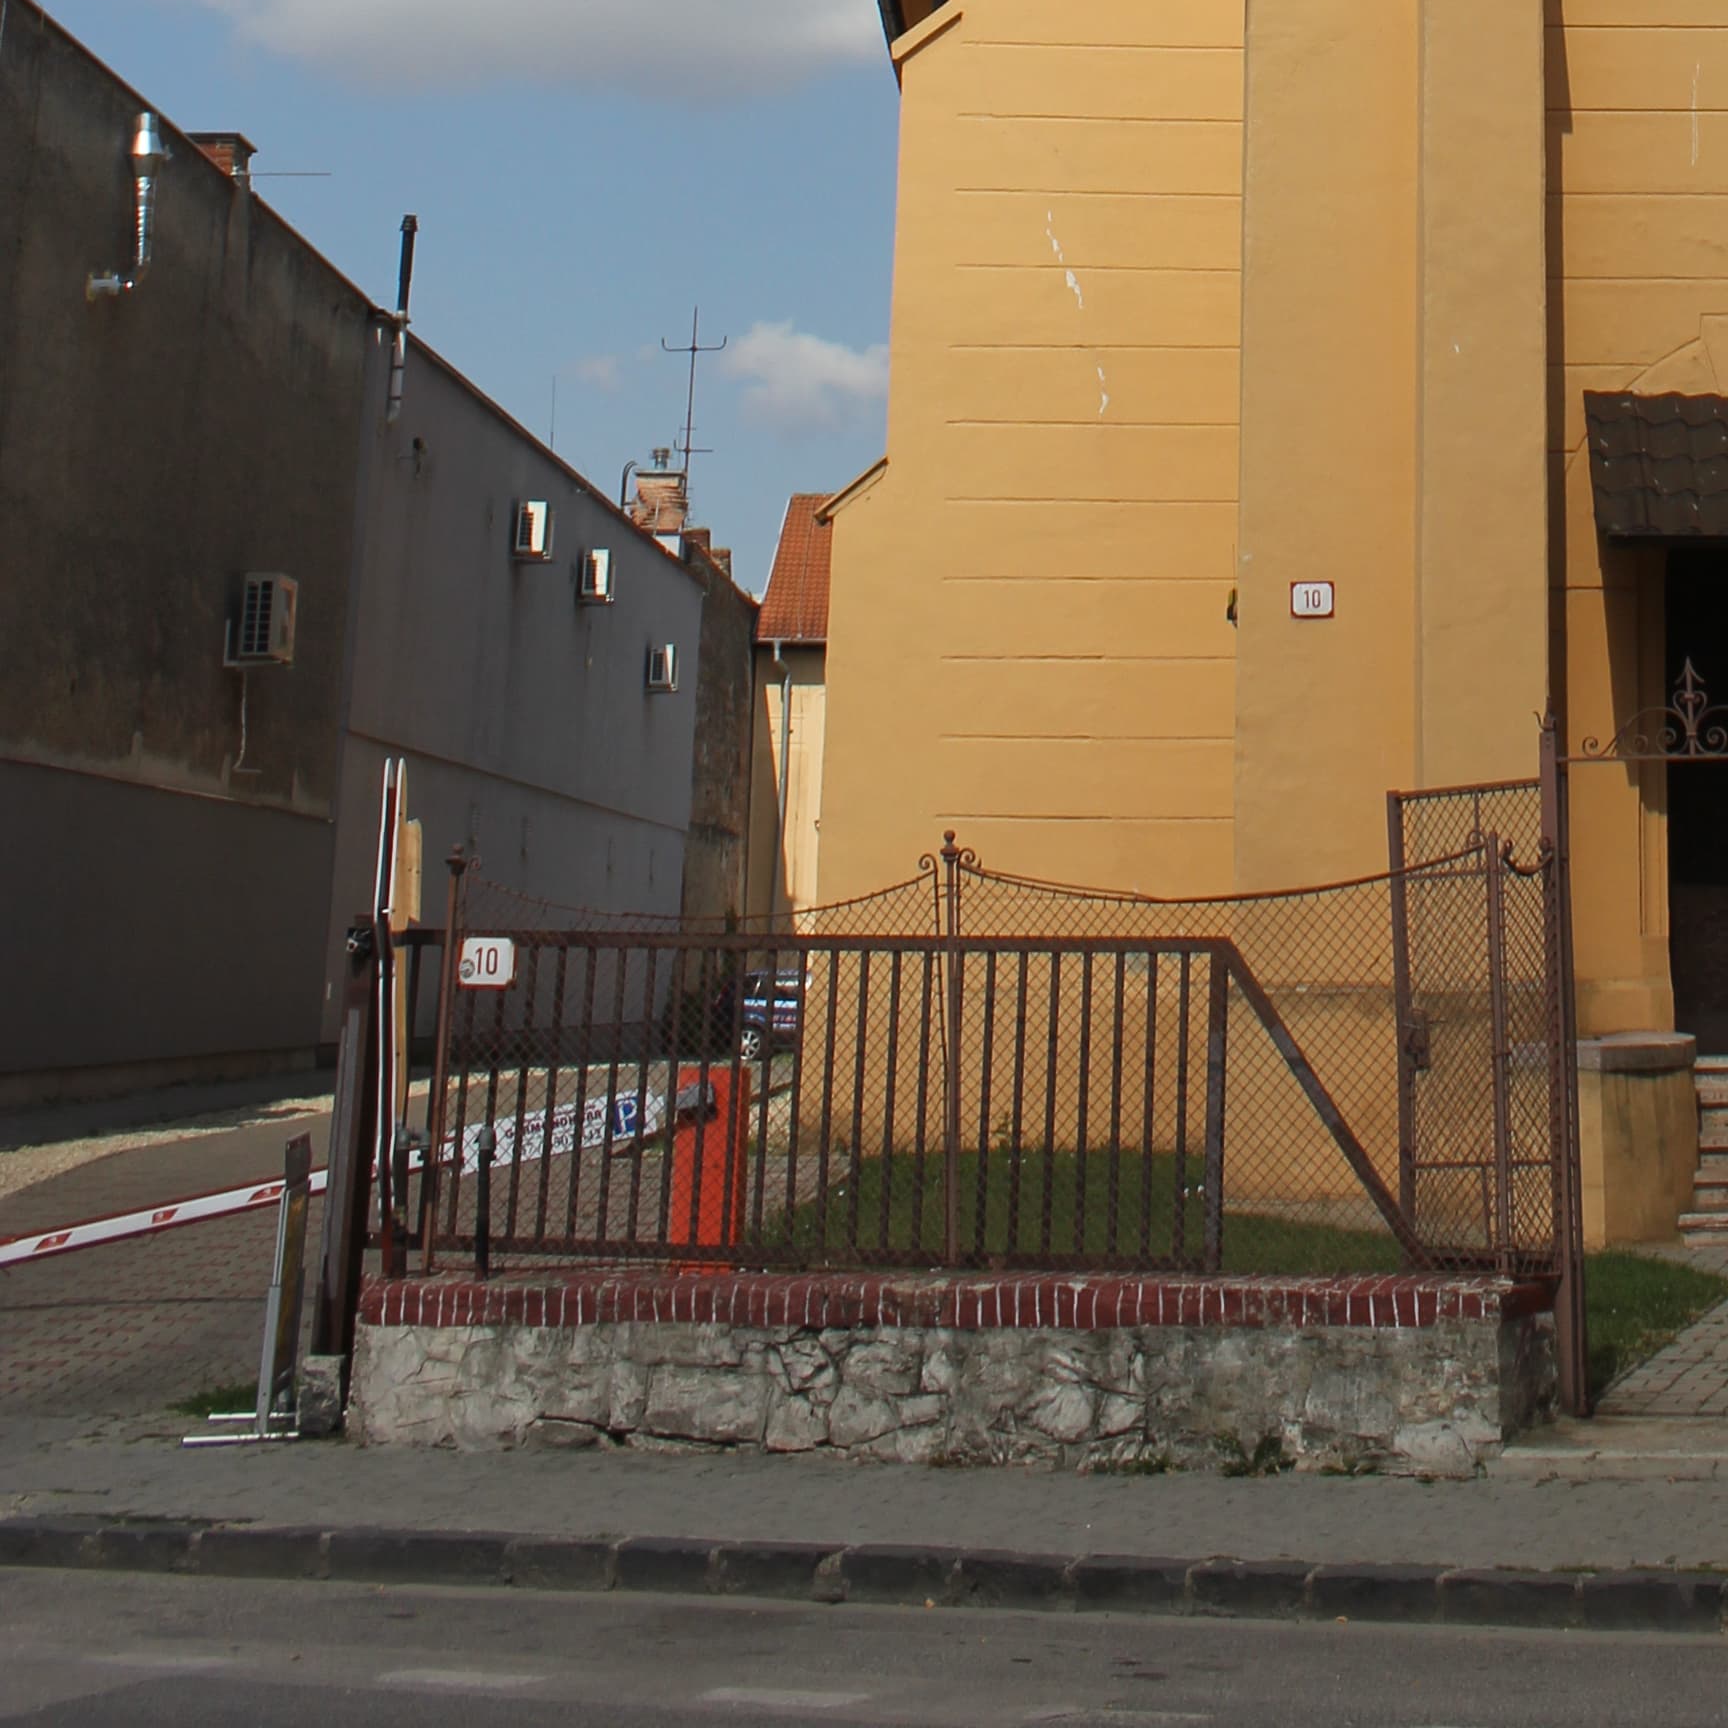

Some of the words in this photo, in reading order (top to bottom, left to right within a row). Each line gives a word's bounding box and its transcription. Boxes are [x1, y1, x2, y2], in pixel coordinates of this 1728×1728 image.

[1303, 589, 1321, 609] 10
[475, 946, 499, 976] 10
[617, 1099, 638, 1135] P
